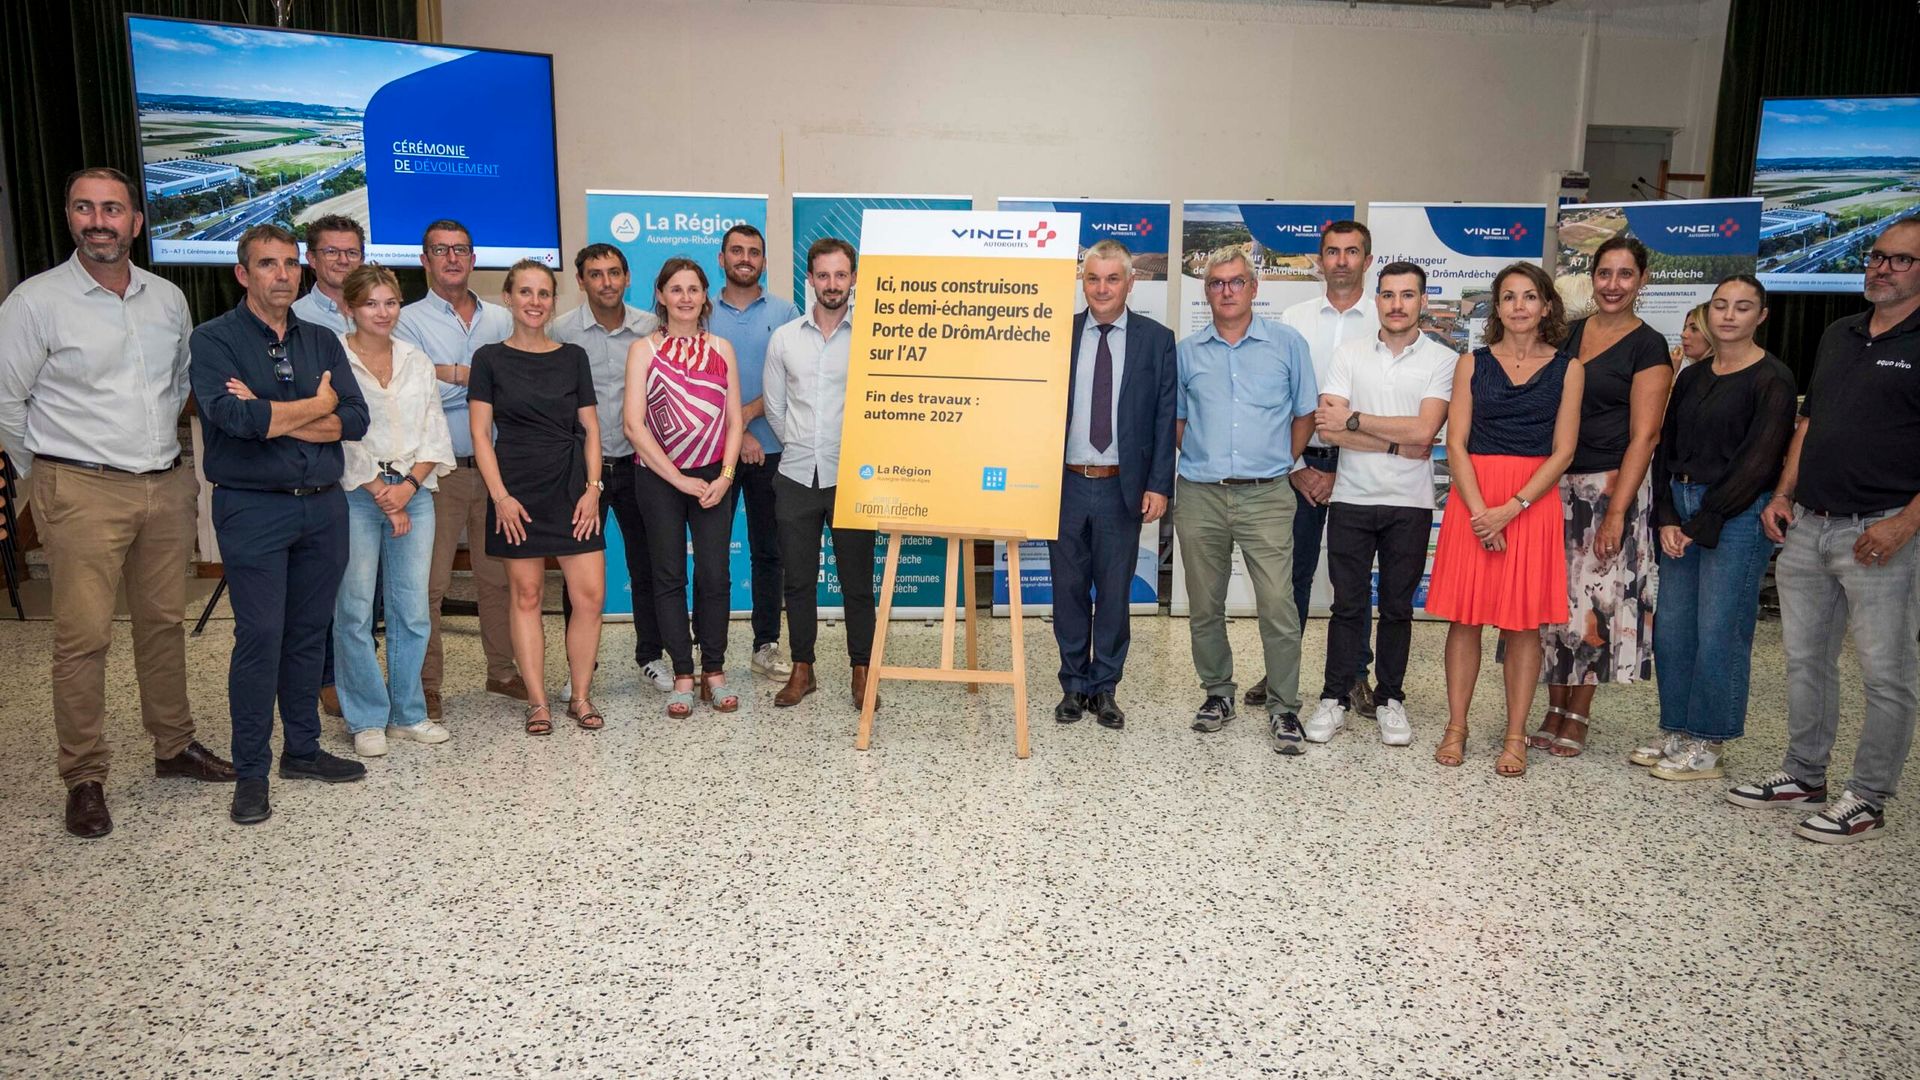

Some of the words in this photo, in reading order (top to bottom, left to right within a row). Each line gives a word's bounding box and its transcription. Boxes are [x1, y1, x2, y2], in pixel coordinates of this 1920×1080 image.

[393, 139, 466, 156] CÉRÉMONIE
[394, 159, 411, 171] DE
[414, 159, 500, 175] DÉVOILEMENT
[645, 212, 670, 231] La
[674, 212, 747, 235] Région
[1091, 223, 1132, 231] VINCI
[1276, 224, 1317, 232] VINCI
[1666, 224, 1715, 234] VINCI
[951, 228, 1022, 240] VINCI
[1464, 227, 1506, 236] VINCI
[646, 234, 723, 246] Auvergne-Rhône-
[1193, 252, 1205, 261] A7
[1377, 255, 1389, 264] A7
[1569, 257, 1584, 267] A7
[1432, 269, 1497, 279] DrômArdèche
[1652, 269, 1704, 278] mArdèche
[876, 276, 897, 294] Ici,
[900, 279, 937, 293] nous
[941, 278, 1039, 295] construisons
[874, 298, 895, 315] les
[898, 299, 1029, 322] demi-échangeurs
[1033, 302, 1053, 319] de
[872, 322, 914, 338] Porte
[918, 322, 937, 339] de
[941, 324, 1051, 343] DrômArdèche
[869, 347, 894, 361] sur
[897, 345, 928, 362] l'A7
[865, 390, 886, 402] Fin
[890, 391, 914, 404] des
[918, 392, 972, 406] travaux
[864, 409, 926, 422] automne
[930, 410, 964, 423] 2027
[877, 465, 890, 474] La
[892, 465, 931, 478] Région
[895, 574, 940, 583] communes
